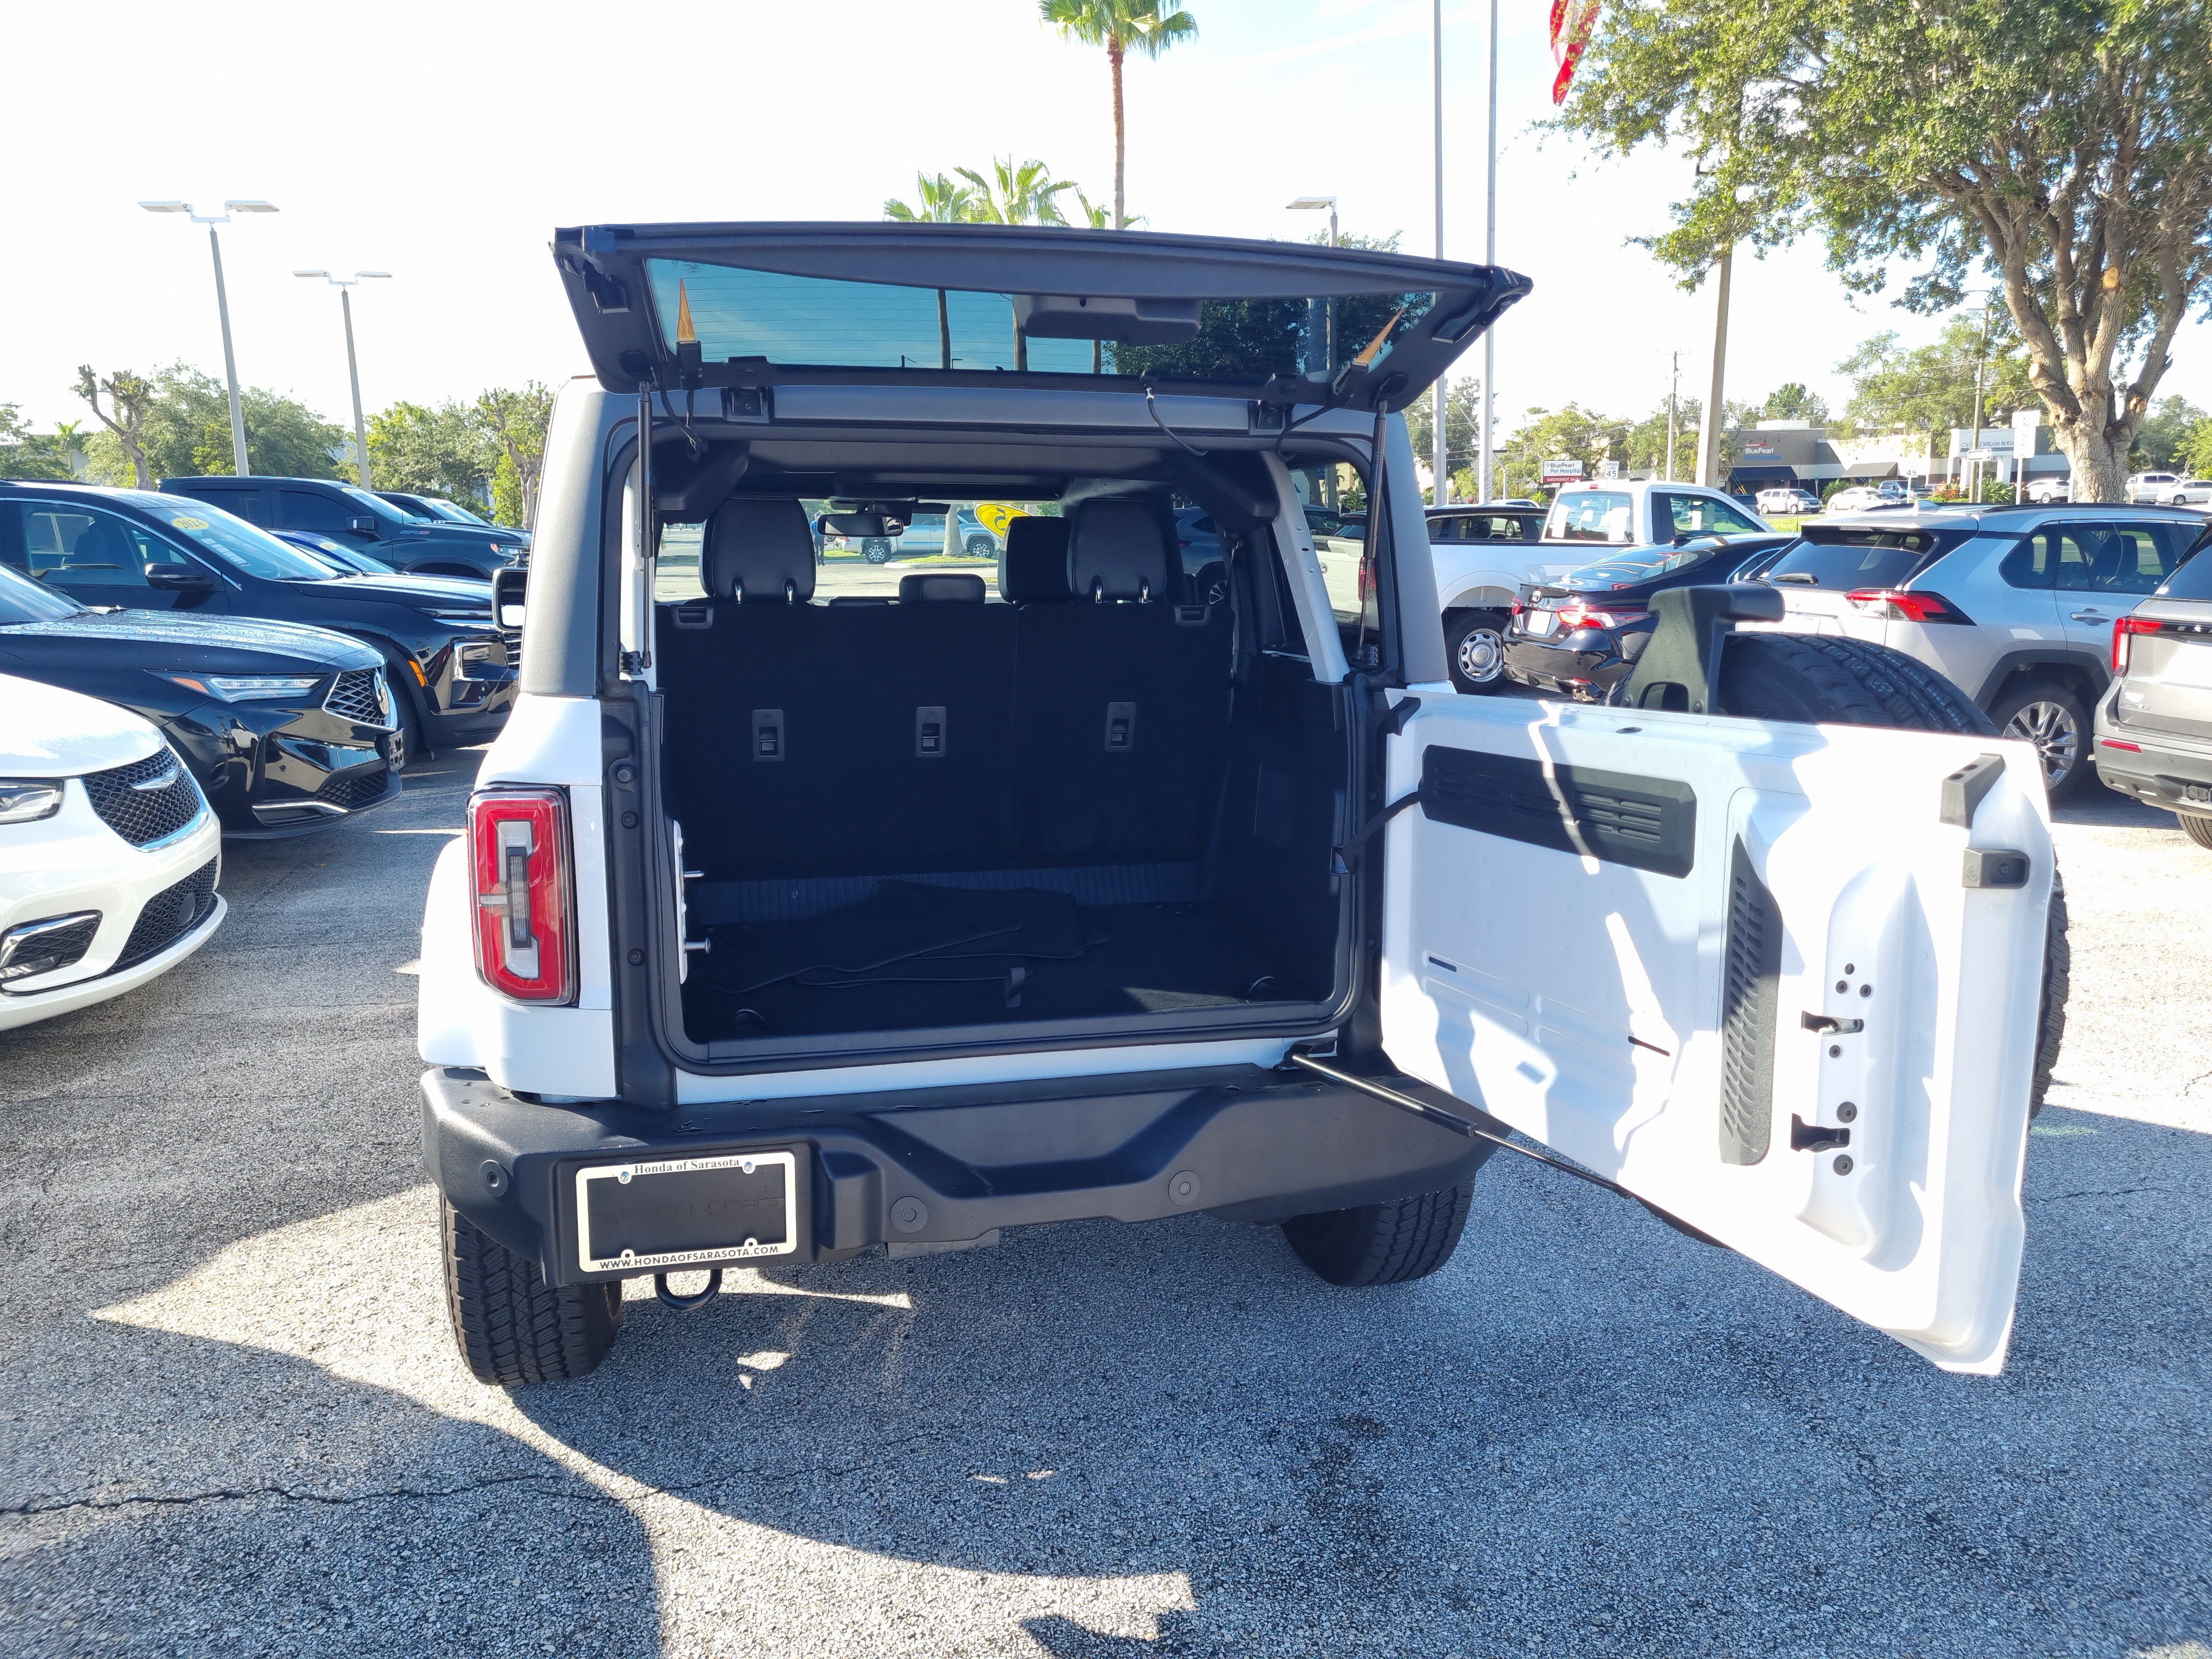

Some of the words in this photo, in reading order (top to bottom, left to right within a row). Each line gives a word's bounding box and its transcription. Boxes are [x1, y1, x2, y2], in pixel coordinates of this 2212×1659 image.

[634, 1164, 673, 1175] Honda
[676, 1161, 689, 1171] of
[691, 1158, 740, 1170] Sarasota
[600, 1245, 779, 1269] WWW.HONDAOFSARASOTA.COM
